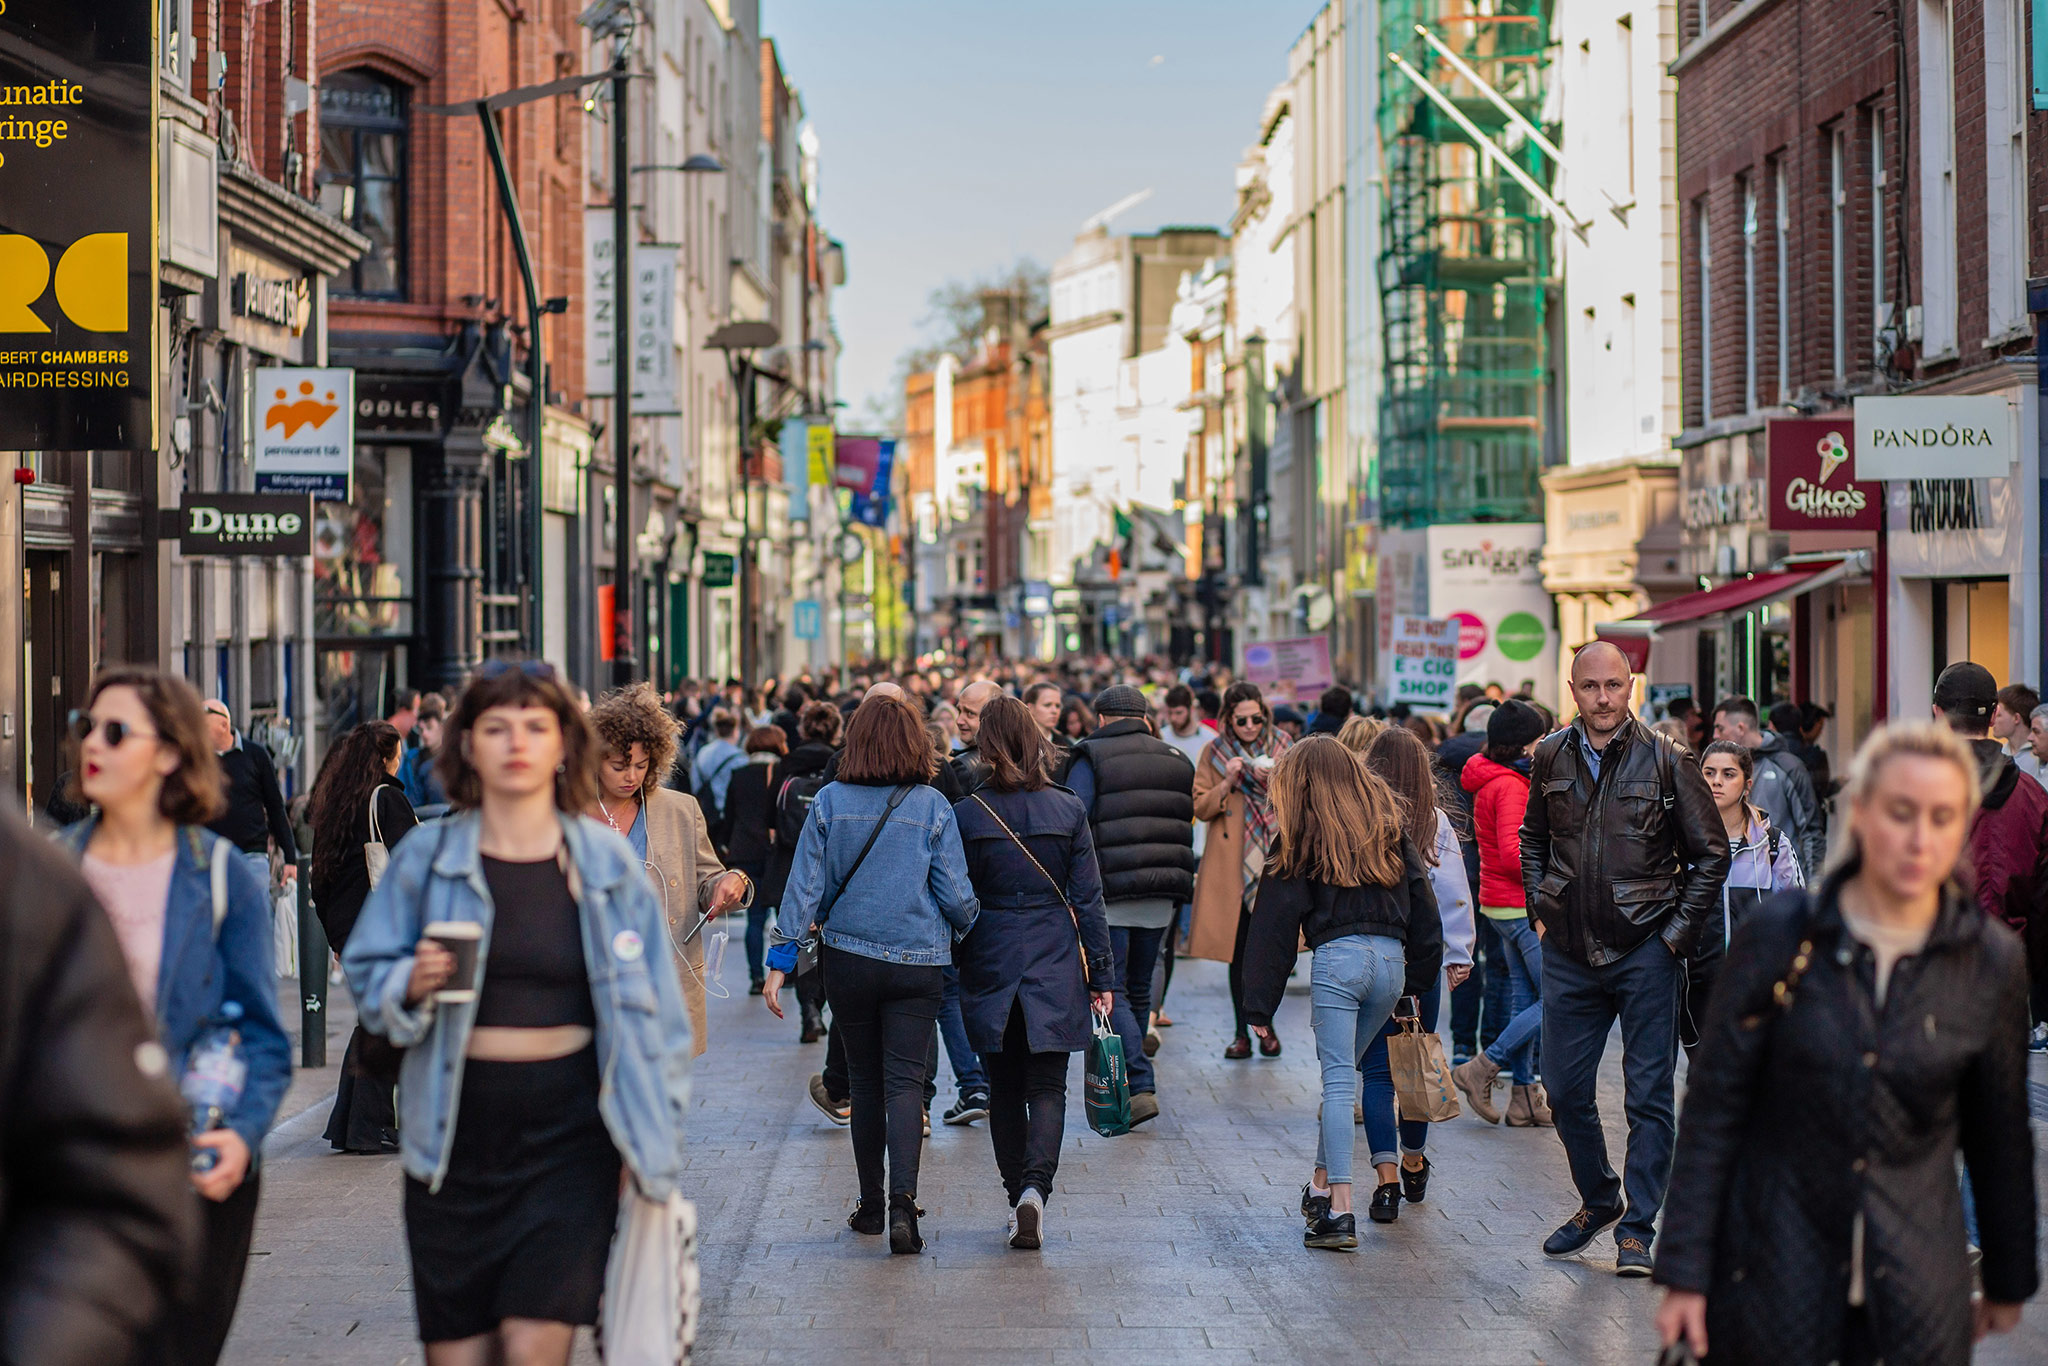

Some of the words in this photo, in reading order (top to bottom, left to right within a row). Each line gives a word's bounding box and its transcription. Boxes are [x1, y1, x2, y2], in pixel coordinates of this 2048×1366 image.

[0, 79, 83, 105] unatic
[593, 239, 613, 366] LINKS
[637, 268, 657, 374] ROCKS
[0, 351, 38, 365] BERT
[41, 350, 129, 365] CHAMBERS
[1873, 423, 1993, 448] PANDORA
[1785, 477, 1867, 514] Gino's
[189, 507, 302, 535] Dune
[1423, 659, 1455, 676] CIG
[1399, 680, 1449, 697] SHOP
